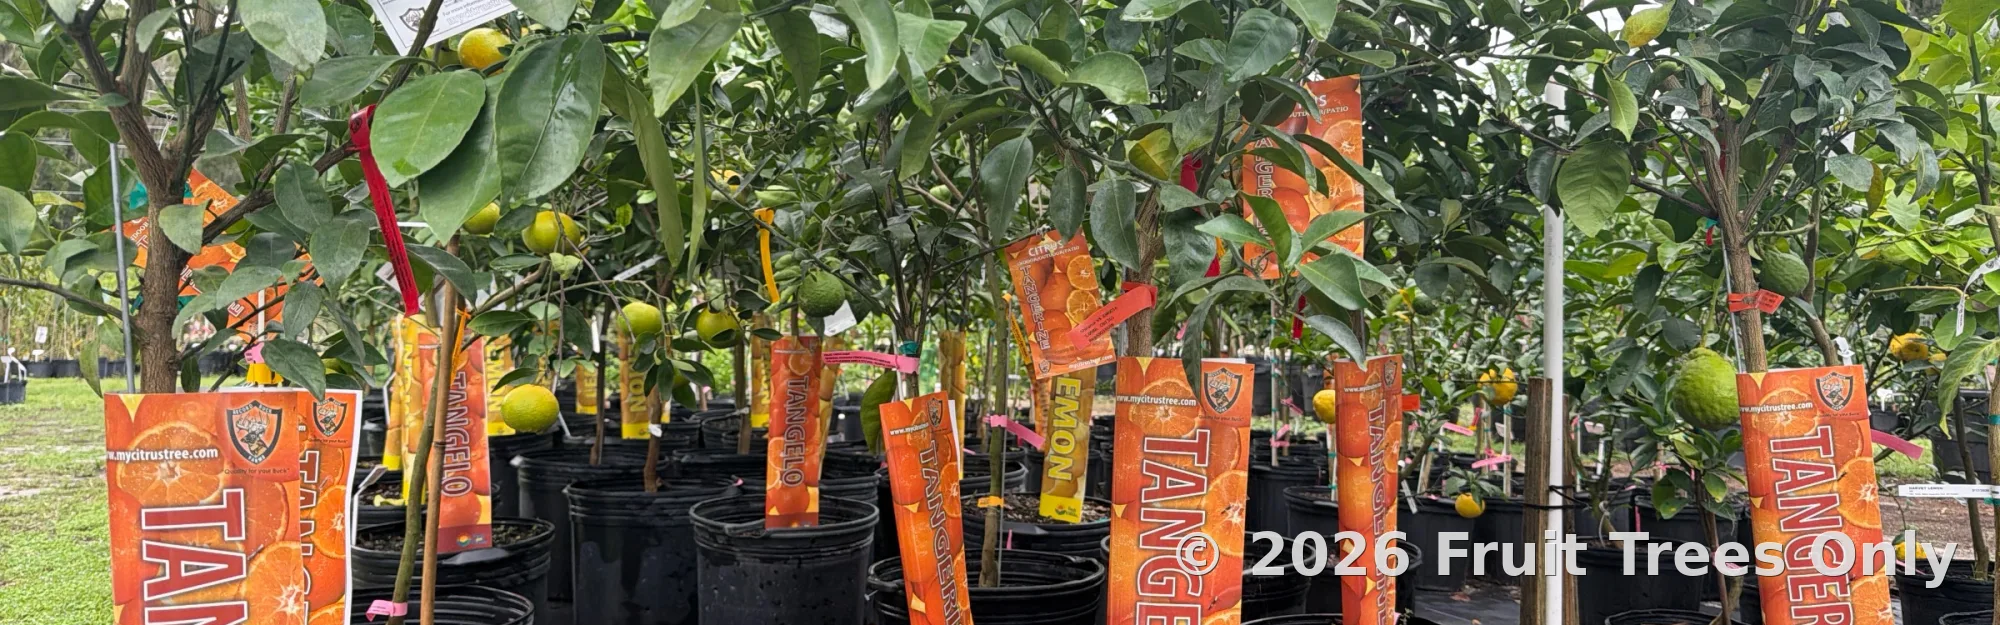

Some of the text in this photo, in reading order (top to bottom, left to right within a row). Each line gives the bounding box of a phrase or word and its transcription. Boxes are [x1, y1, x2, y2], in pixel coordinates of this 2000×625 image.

[1028, 240, 1064, 257] CITRUS
[1020, 265, 1050, 350] TANGERINE
[259, 404, 272, 413] BUCK
[442, 371, 472, 497] TANGELO
[782, 375, 809, 487] TANGELO
[1048, 373, 1082, 481] EMON
